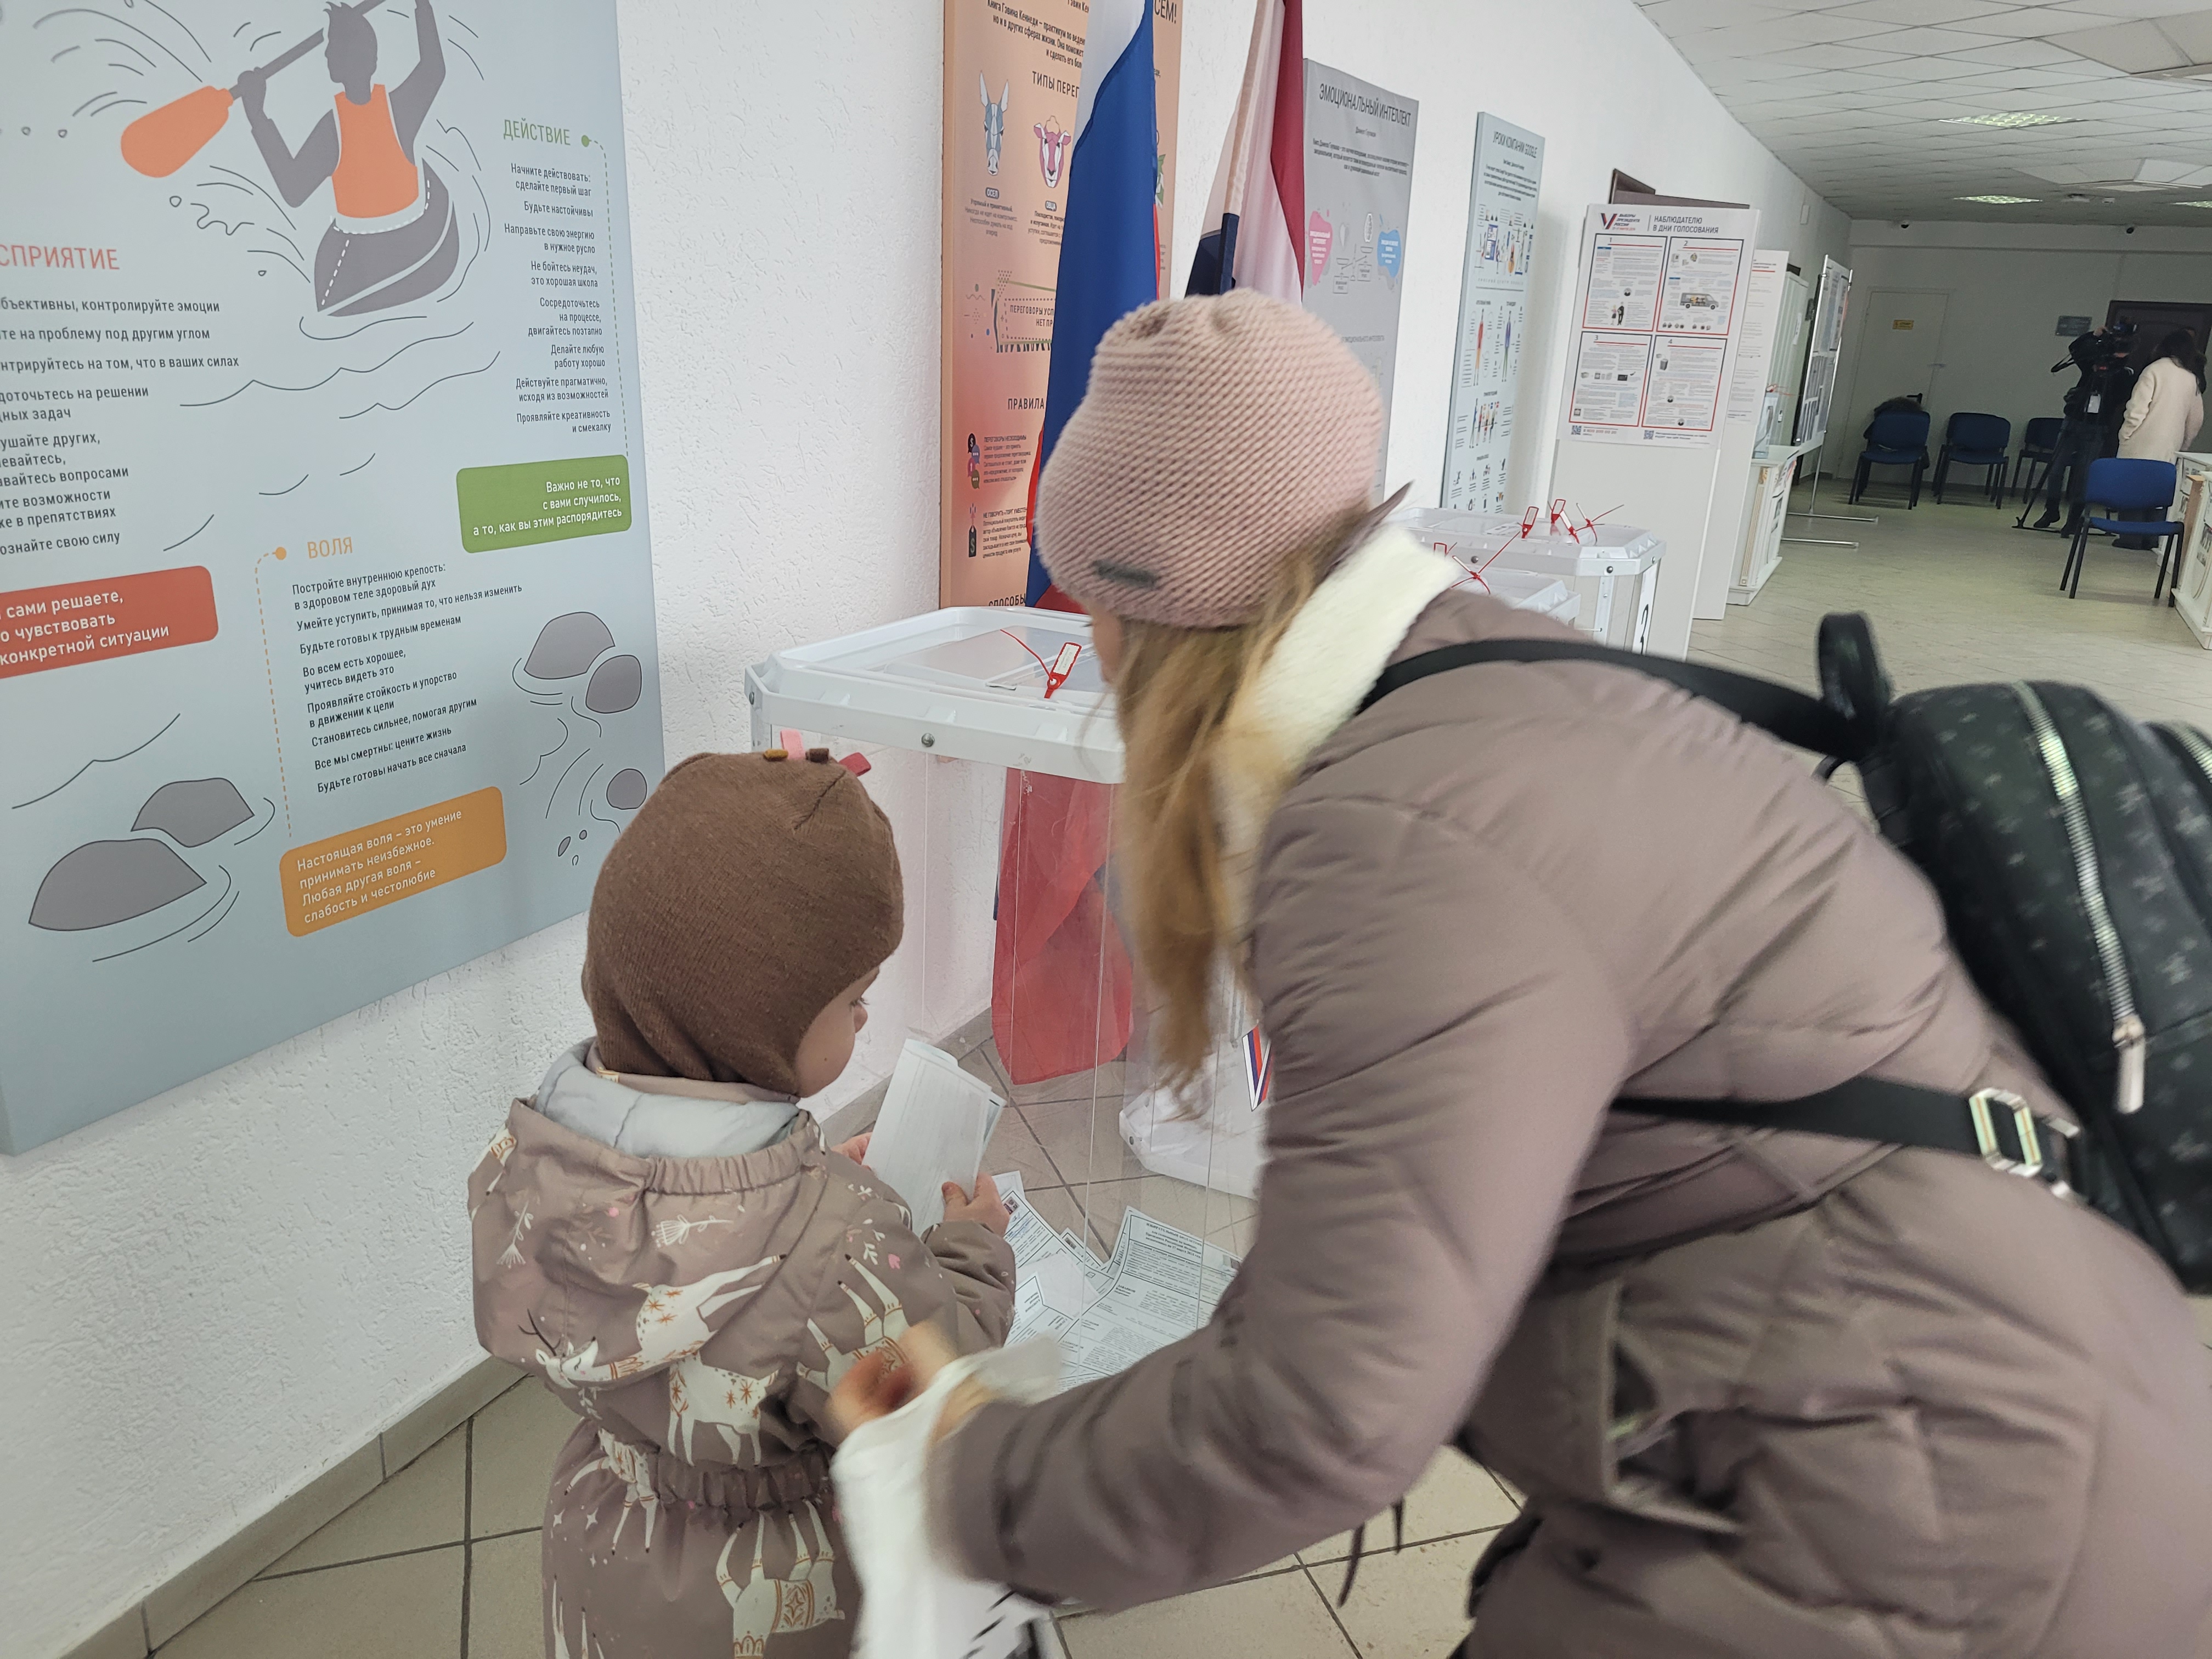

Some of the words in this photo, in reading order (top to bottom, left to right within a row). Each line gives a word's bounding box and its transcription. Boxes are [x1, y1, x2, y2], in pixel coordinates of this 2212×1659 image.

[1007, 21, 1023, 33] других
[1024, 26, 1041, 41] сферах
[1049, 50, 1066, 63] сделать
[1032, 71, 1054, 91] ТИПЫ
[1319, 83, 1379, 118] ЭМОЦИОНАЛЬНЫЙ
[504, 117, 571, 145] ДЕЙСТВИЕ
[511, 163, 541, 176] Начните
[544, 168, 590, 182] действовать:
[516, 181, 549, 191] сделайте
[551, 185, 576, 195] первый
[578, 188, 591, 196] шаг
[524, 201, 550, 213] Будьте
[551, 205, 593, 217] настойчивы
[1654, 216, 1702, 224] НАБЛЮДАТЕЛЮ
[505, 223, 545, 236] Направьте
[548, 229, 565, 237] свою
[566, 230, 594, 240] энергию
[1673, 225, 1719, 234] ГОЛОСОВАНИЯ
[531, 261, 541, 270] Не
[543, 261, 571, 272] бойтесь
[572, 265, 597, 275] неудач,
[1, 297, 78, 312] бъективны,
[82, 299, 174, 314] контролируйте
[177, 303, 219, 314] эмоции
[540, 297, 600, 309] Сосредоточьтесь
[1010, 304, 1043, 315] ПЕРЕГОВОРЫ
[528, 326, 571, 337] двигайтесь
[551, 344, 581, 356] Делайте
[583, 344, 604, 356] любую
[1, 358, 84, 374] нтрируйтесь
[88, 360, 103, 369] на
[106, 360, 133, 370] том,
[136, 359, 156, 368] что
[159, 359, 166, 368] в
[169, 358, 204, 367] ваших
[207, 358, 239, 366] силах
[555, 358, 579, 370] работу
[581, 360, 605, 369] хорошо
[516, 377, 558, 390] Действуйте
[561, 378, 607, 388] прагматично,
[0, 390, 74, 404] доточьтесь
[77, 390, 92, 398] на
[96, 388, 148, 401] решении
[1008, 398, 1045, 410] ПРАВИЛА
[517, 411, 560, 425] Проявляйте
[562, 411, 610, 422] креативность
[0, 435, 48, 451] ушайте
[53, 434, 100, 448] других,
[546, 482, 574, 493] Важно
[578, 481, 588, 489] не
[590, 479, 602, 488] то,
[605, 477, 620, 486] что
[550, 499, 571, 509] вами
[574, 494, 621, 507] случилось,
[473, 527, 479, 535] а
[482, 526, 496, 535] то,
[499, 522, 516, 532] как
[518, 521, 531, 530] вы
[533, 517, 554, 528] этим
[557, 509, 622, 527] распорядитесь
[0, 539, 52, 555] ознайте
[57, 537, 89, 548] свою
[93, 533, 120, 545] силу
[307, 537, 353, 559] ВОЛЯ
[292, 579, 344, 595] Постройте
[347, 571, 402, 587] внутреннюю
[405, 564, 445, 579] крепость:
[7, 602, 46, 618] сами
[52, 592, 123, 615] решаете,
[297, 617, 333, 631] Умейте
[335, 611, 379, 627] уступить,
[381, 602, 422, 618] принимая
[439, 597, 453, 605] что
[455, 591, 482, 602] нельзя
[484, 585, 522, 597] изменить
[1, 631, 9, 642] о
[15, 614, 115, 641] чувствовать
[0, 635, 94, 665] конкретной
[100, 626, 168, 647] ситуации
[303, 667, 315, 677] Во
[318, 663, 341, 674] всем
[343, 658, 364, 668] есть
[366, 650, 405, 664] хорошее,
[307, 693, 364, 714] Проявляйте
[366, 684, 410, 699] стойкость
[419, 672, 456, 689] упорство
[312, 726, 371, 747] Становитесь
[374, 716, 410, 731] сильнее,
[413, 707, 446, 721] помогая
[449, 699, 477, 714] другим
[315, 759, 331, 770] Все
[334, 754, 349, 765] мы
[351, 743, 393, 760] смертны:
[396, 735, 424, 749] цените
[426, 728, 452, 740] жизнь
[297, 843, 363, 871] Настоящая
[367, 833, 392, 849] воля
[405, 824, 422, 836] это
[425, 811, 461, 832] умение
[300, 861, 363, 889] принимать
[367, 838, 434, 866] неизбежное.
[303, 885, 341, 906] Любая
[346, 871, 383, 893] другая
[387, 861, 411, 877] воля
[305, 899, 357, 923] слабость
[361, 894, 368, 903] и
[371, 870, 435, 898] честолюбие
